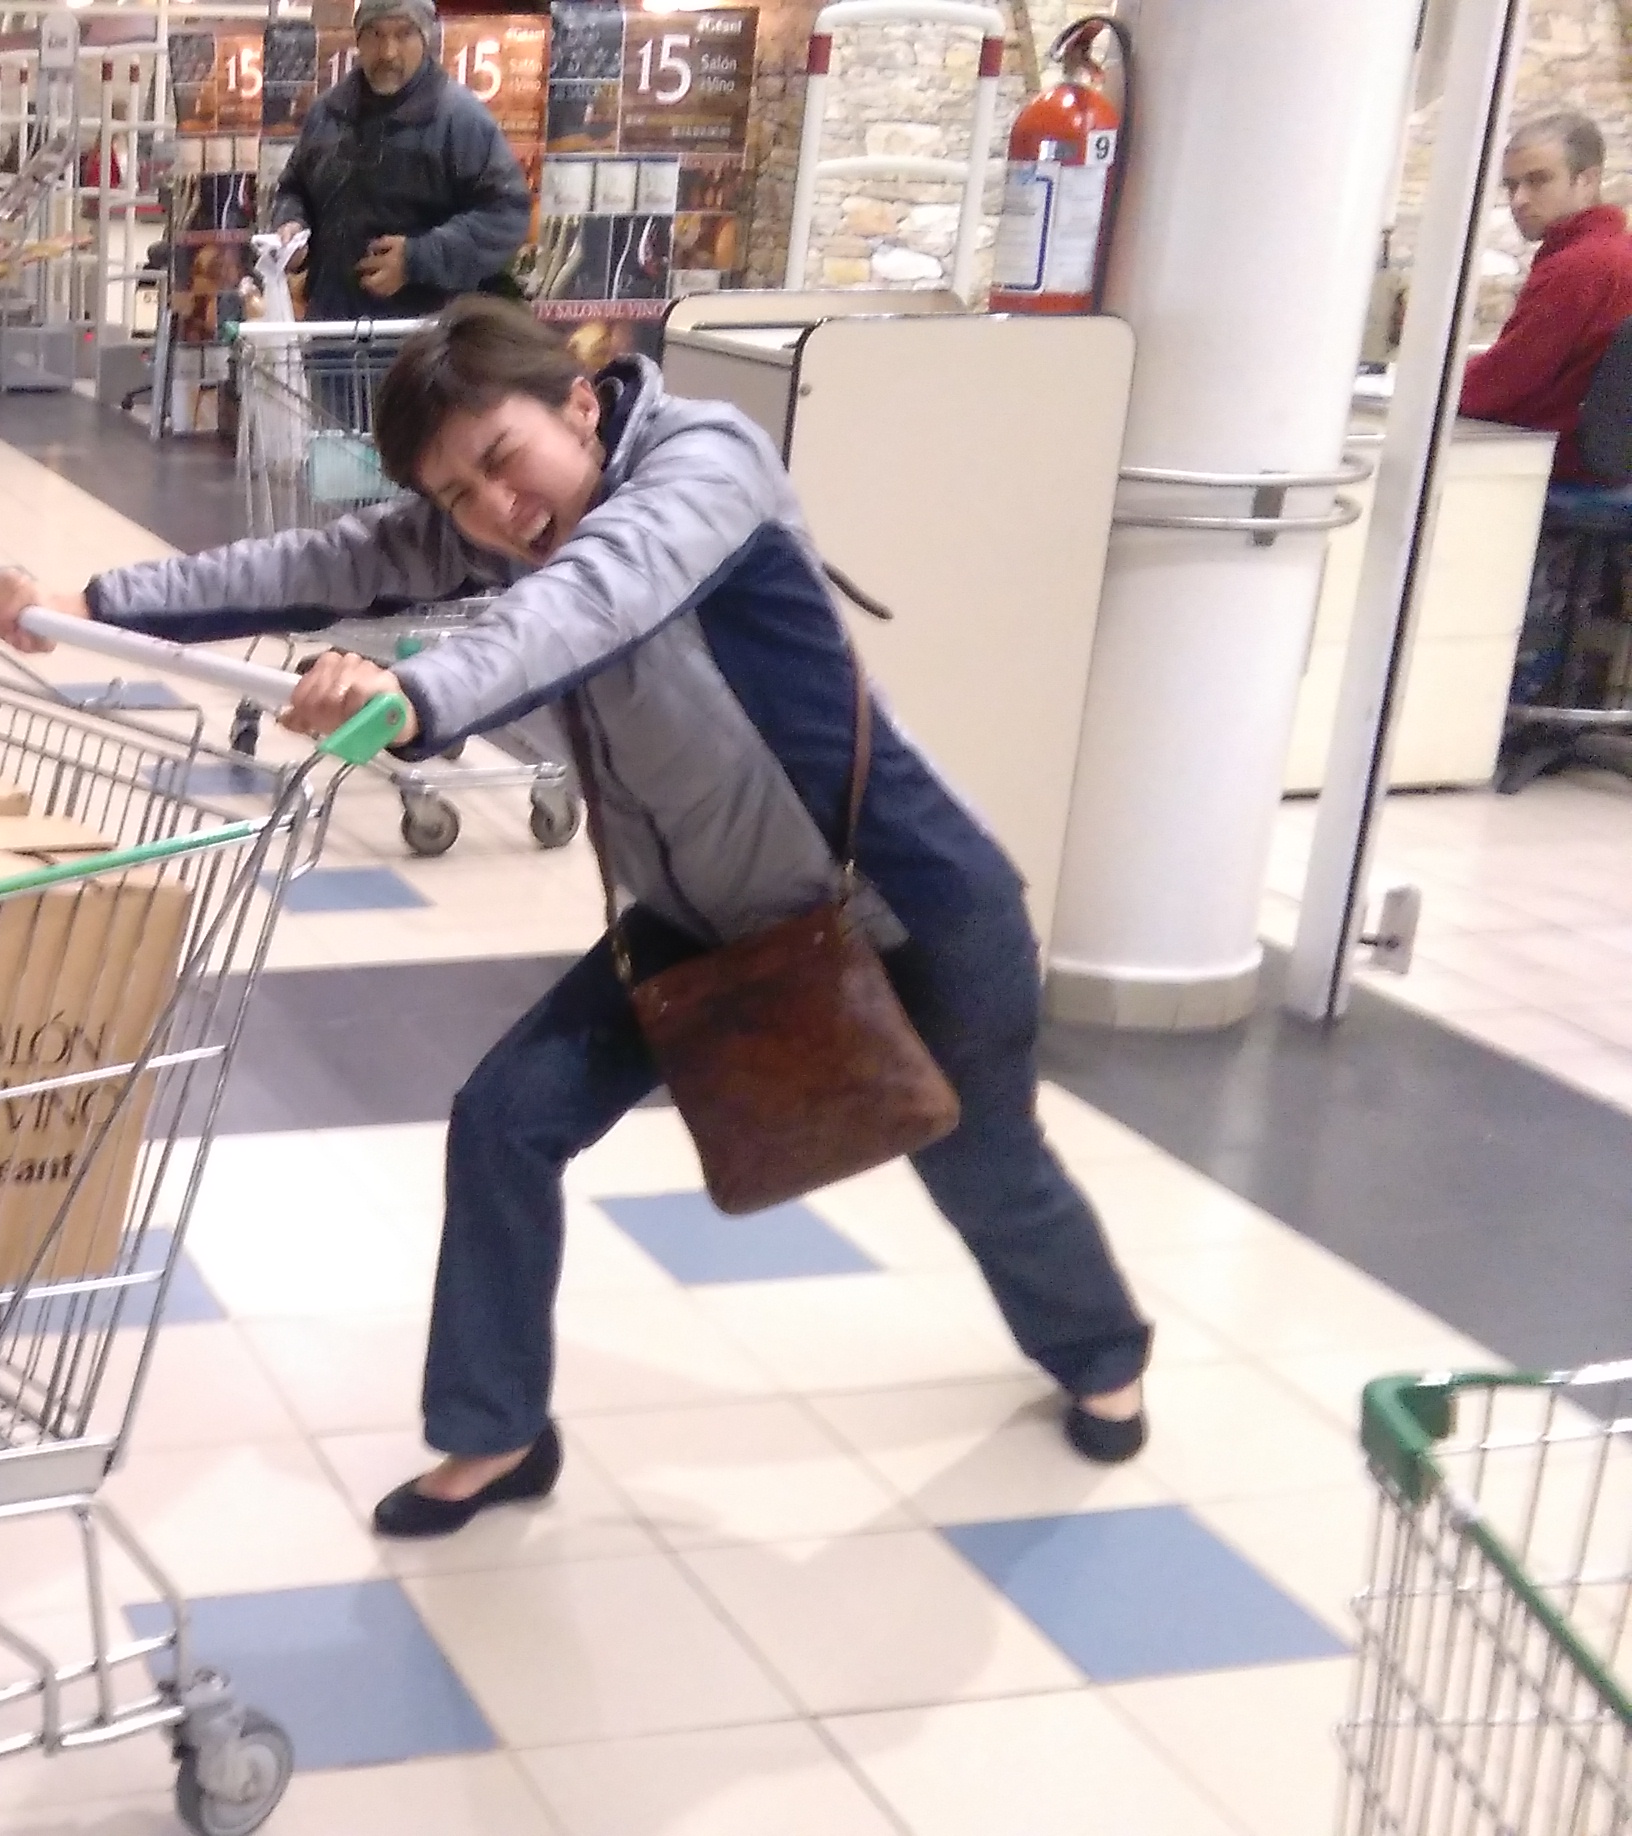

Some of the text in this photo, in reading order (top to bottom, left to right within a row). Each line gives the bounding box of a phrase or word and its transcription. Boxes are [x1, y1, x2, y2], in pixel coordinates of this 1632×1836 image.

[226, 48, 263, 98] 15
[453, 40, 501, 103] 15
[637, 33, 691, 105] 15
[701, 53, 737, 71] Salón
[1095, 136, 1110, 160] 9
